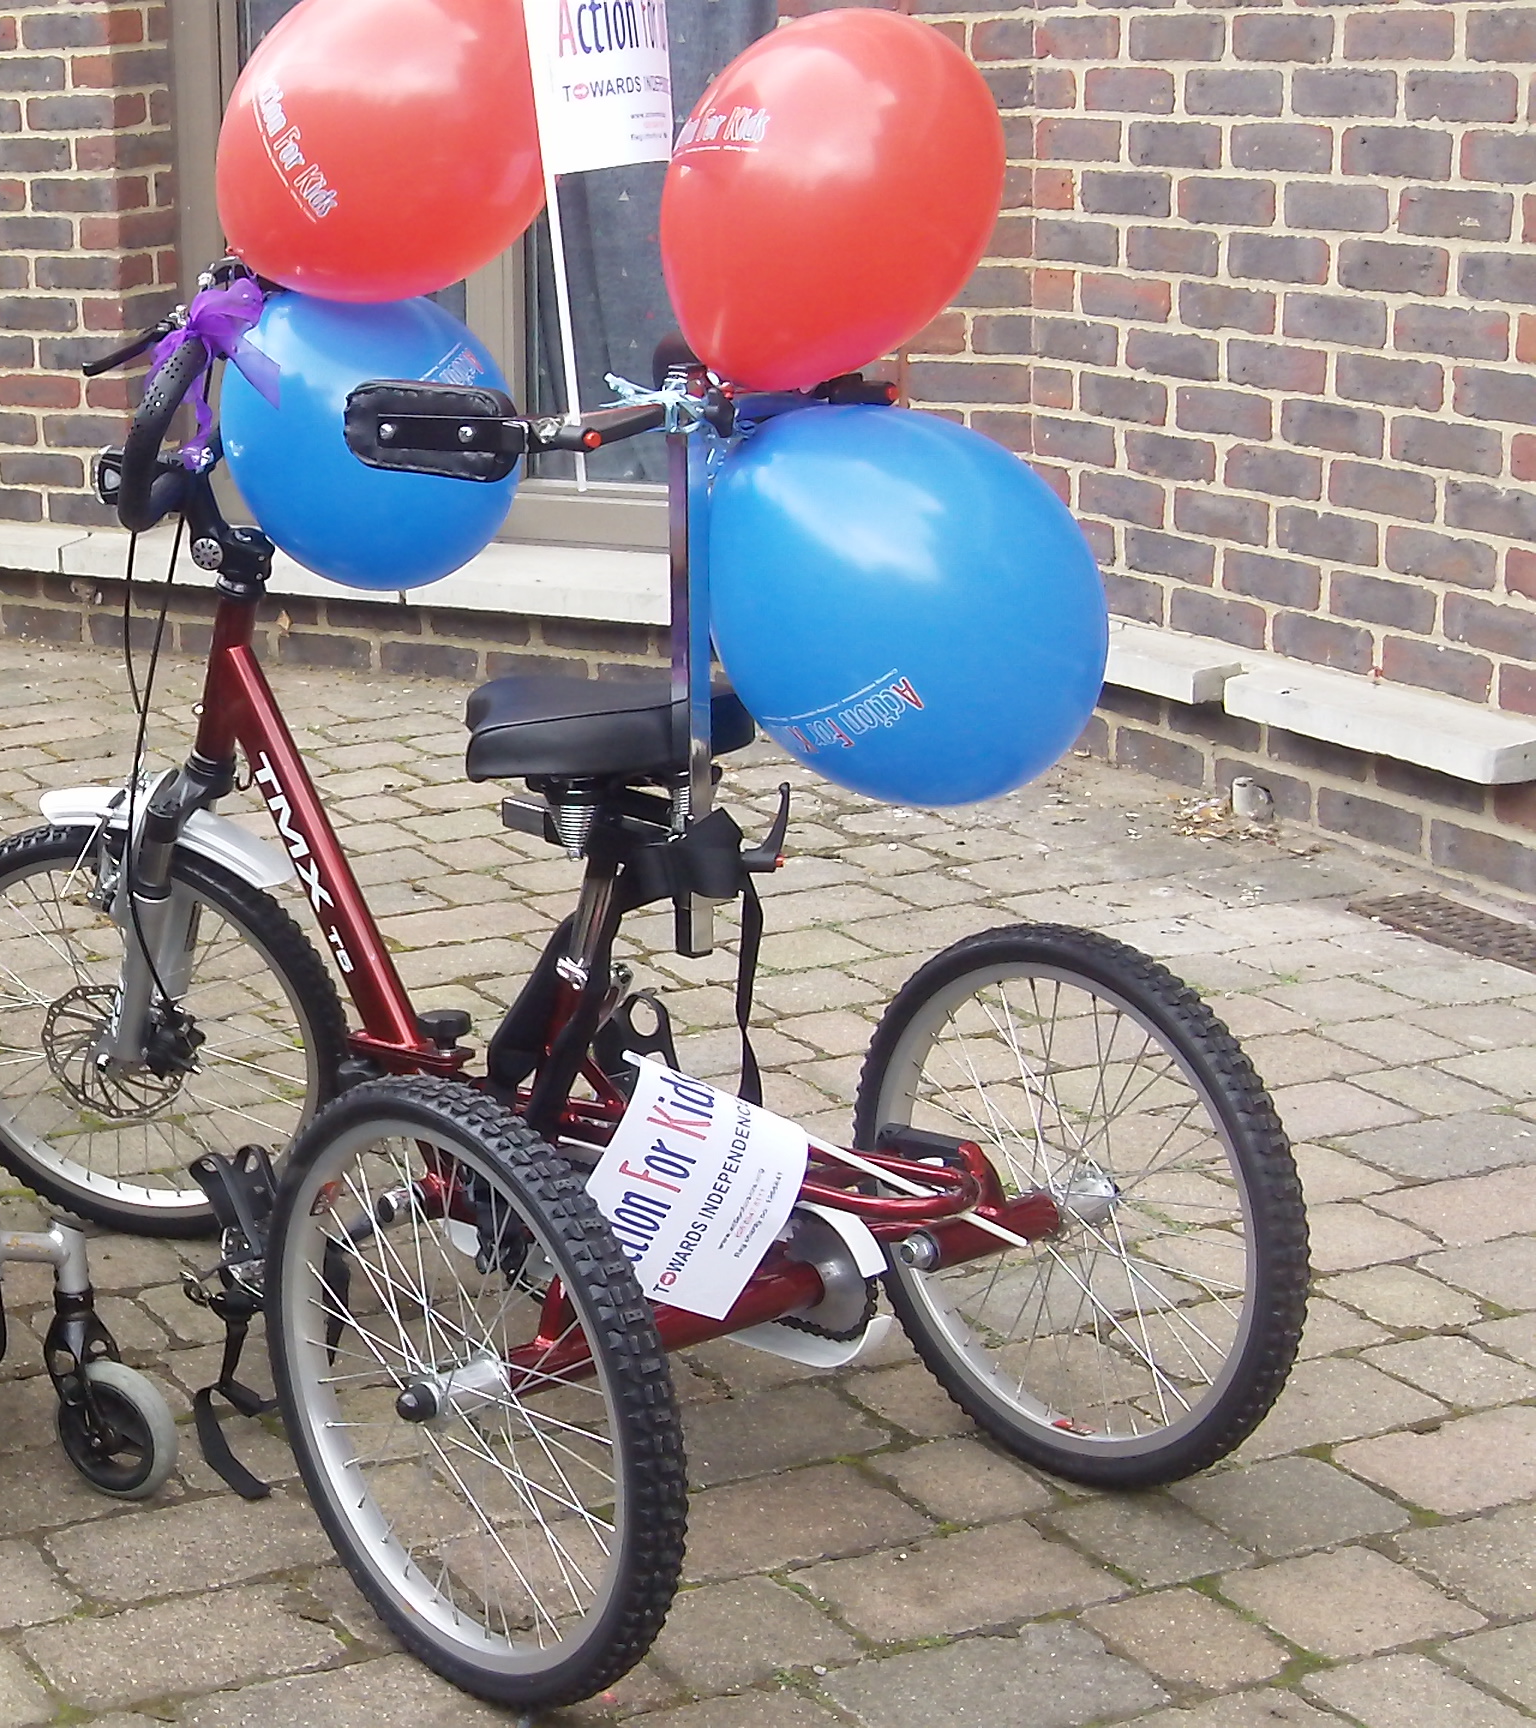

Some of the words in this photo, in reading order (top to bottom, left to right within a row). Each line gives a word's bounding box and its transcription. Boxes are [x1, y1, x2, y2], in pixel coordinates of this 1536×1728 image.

[559, 0, 640, 57] Action
[562, 76, 642, 102] TOWARDS
[273, 125, 305, 171] For
[293, 163, 338, 218] Kids
[805, 716, 855, 749] For
[838, 675, 925, 735] Action
[254, 750, 335, 913] TMX
[618, 1138, 697, 1194] For
[652, 1221, 708, 1294] TOWARDS
